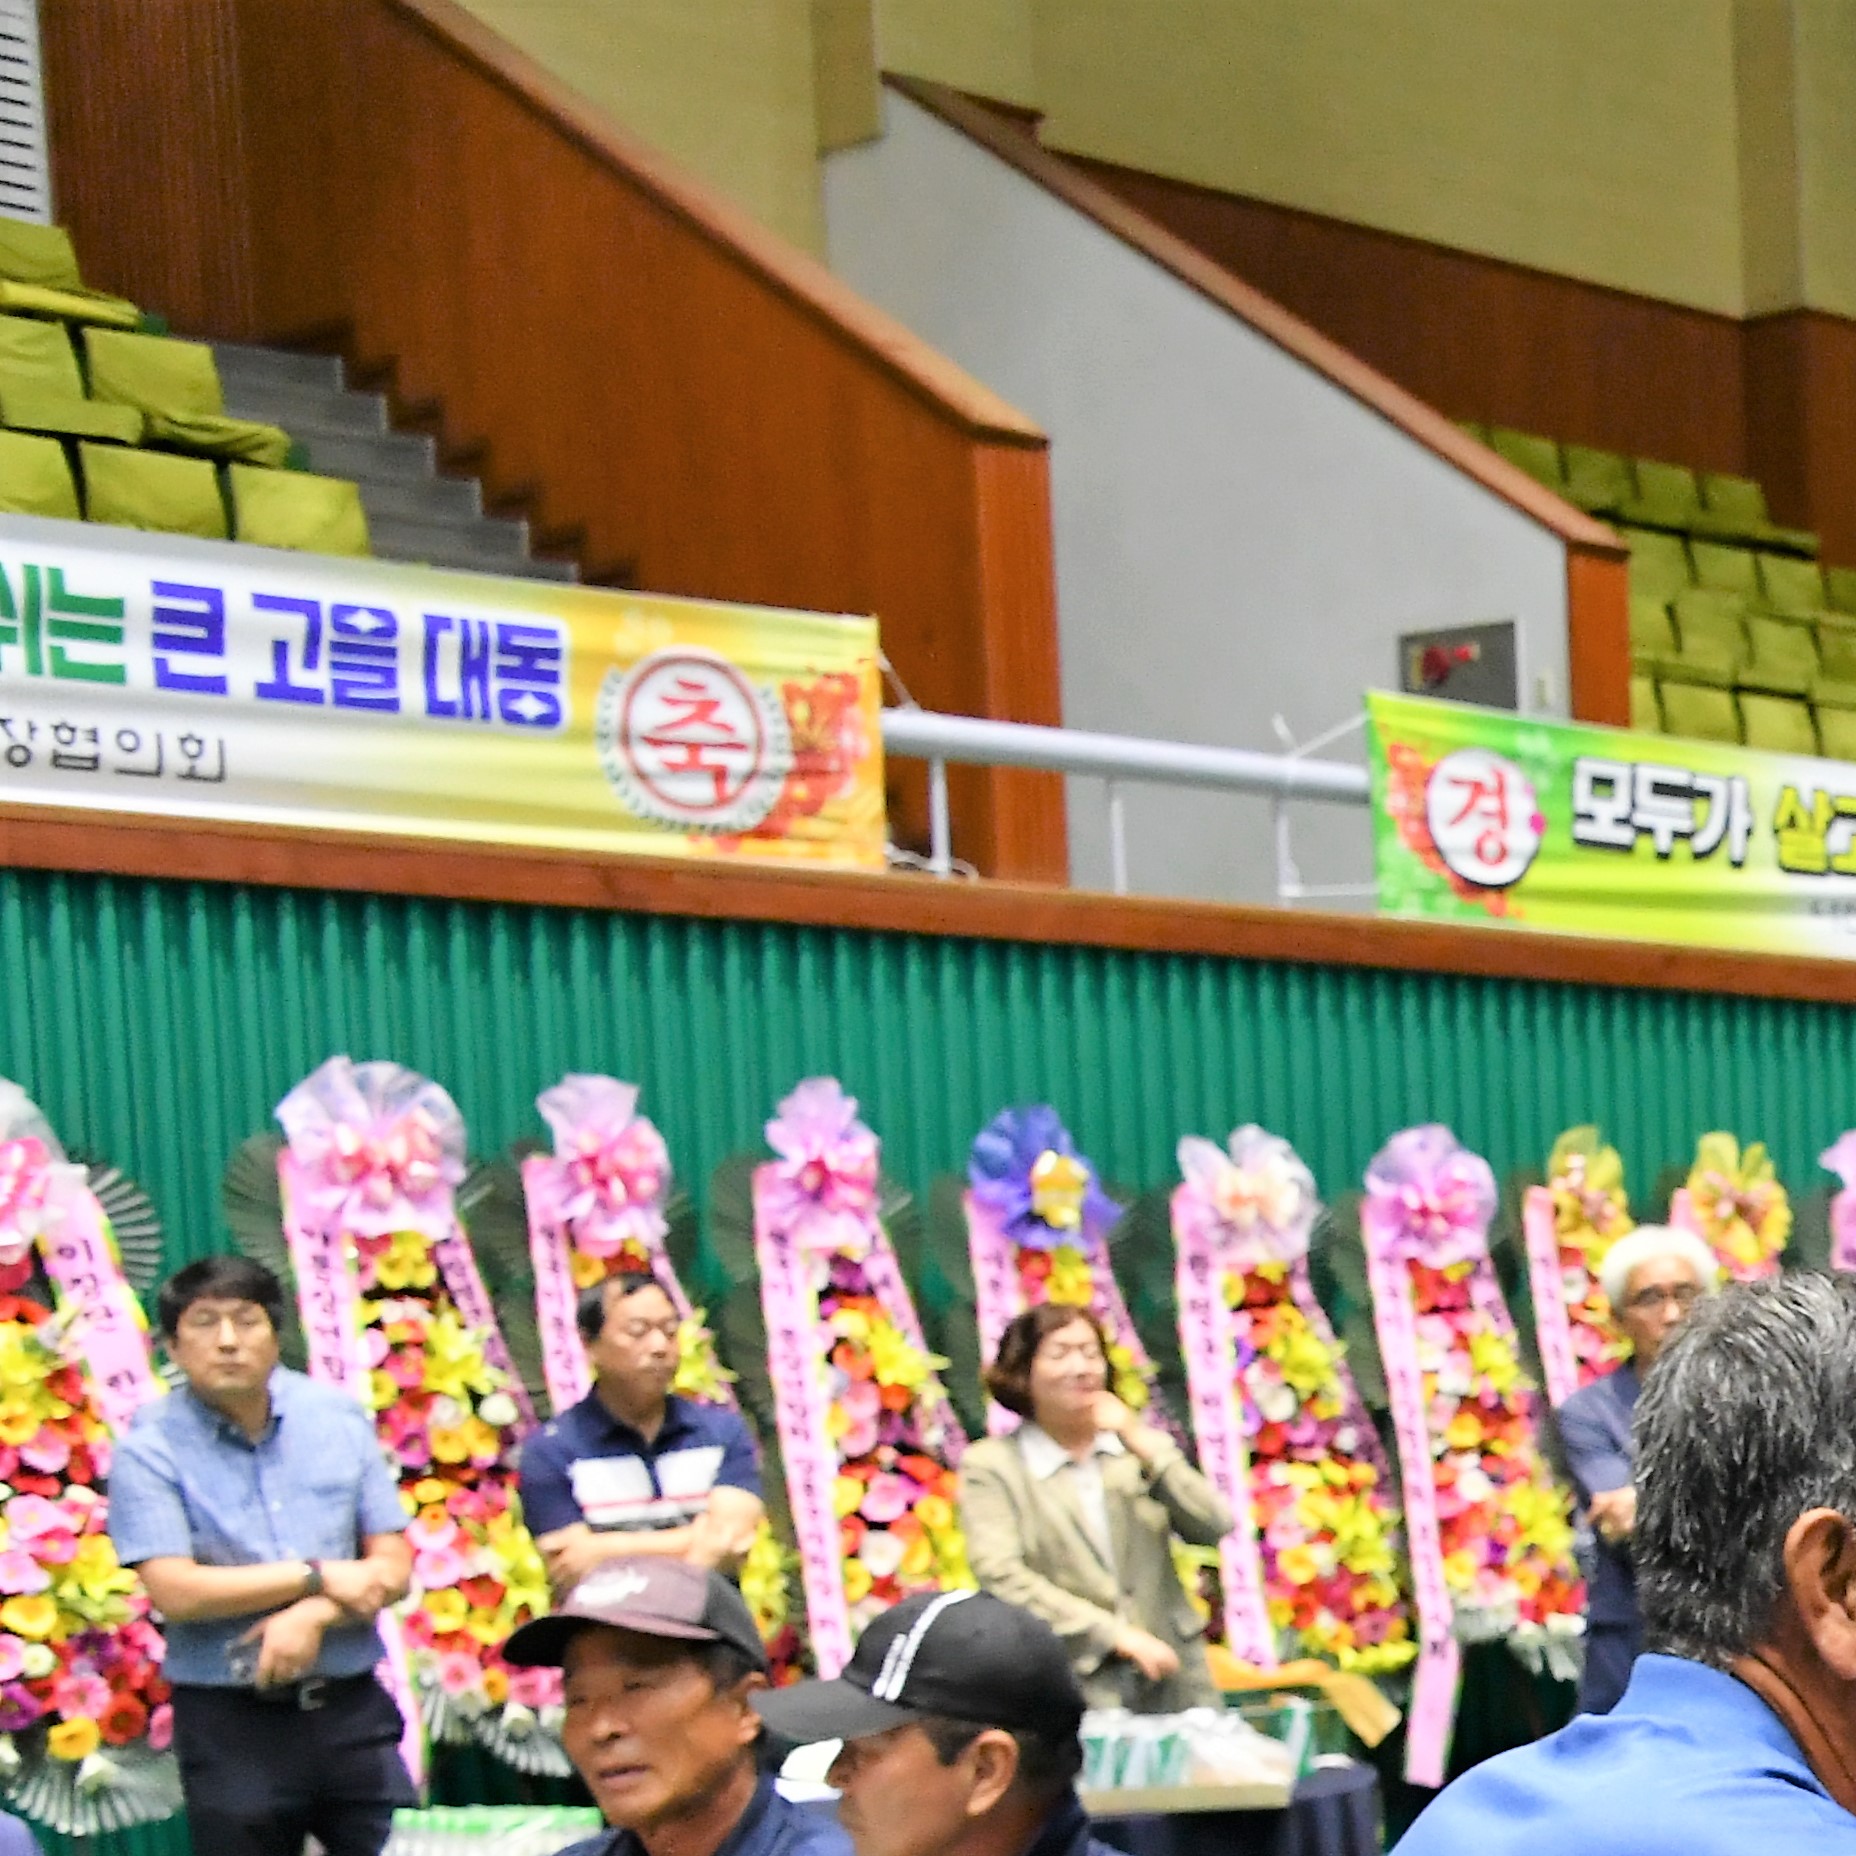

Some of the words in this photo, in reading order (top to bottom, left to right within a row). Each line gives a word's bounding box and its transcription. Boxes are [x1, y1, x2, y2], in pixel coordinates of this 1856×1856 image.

[150, 579, 229, 696] 큰
[251, 592, 401, 715] 고을
[422, 612, 566, 730] 대동
[642, 677, 750, 804] 축
[1448, 766, 1511, 868] 경
[1571, 755, 1754, 870] 모두가
